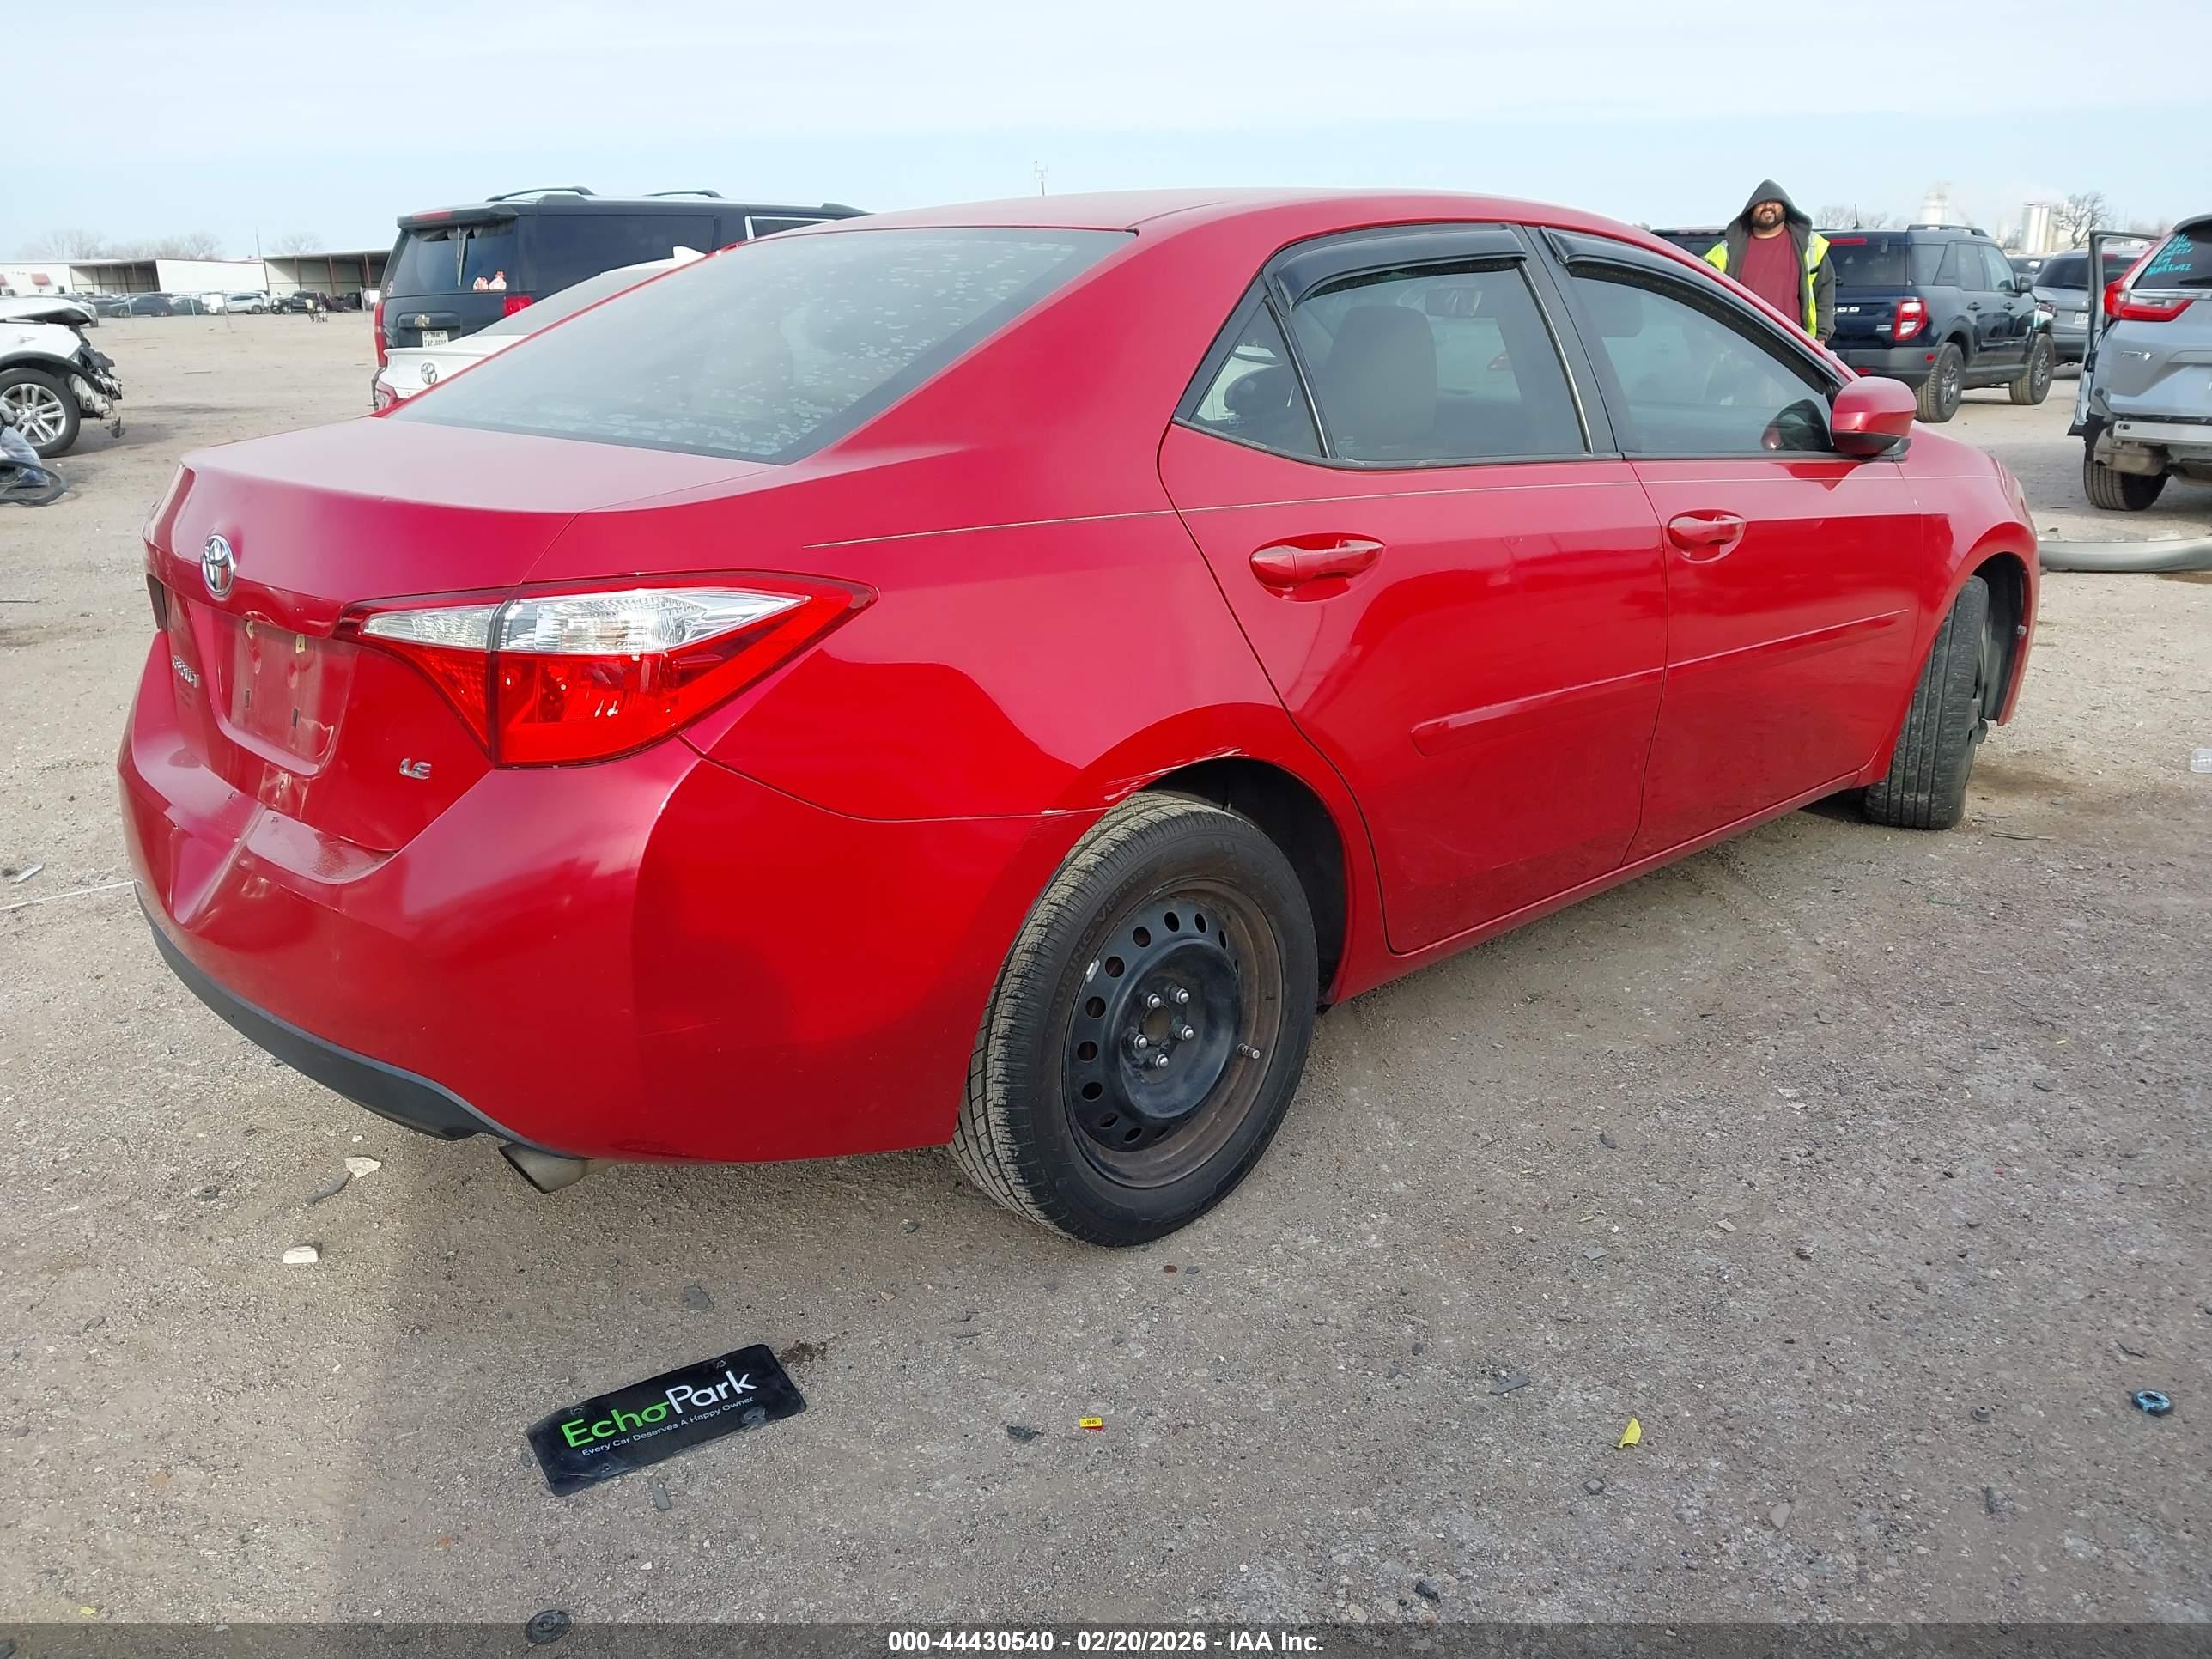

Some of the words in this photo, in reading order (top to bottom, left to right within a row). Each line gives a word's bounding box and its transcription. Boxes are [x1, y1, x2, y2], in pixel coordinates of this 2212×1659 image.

[399, 757, 431, 780] LE
[562, 1370, 757, 1448] EchoPark
[582, 1443, 611, 1457] Every
[612, 1437, 630, 1447] Car
[634, 1423, 678, 1442] Deserves
[680, 1419, 688, 1428] A
[690, 1408, 720, 1424] Happy
[722, 1396, 754, 1411] Owner
